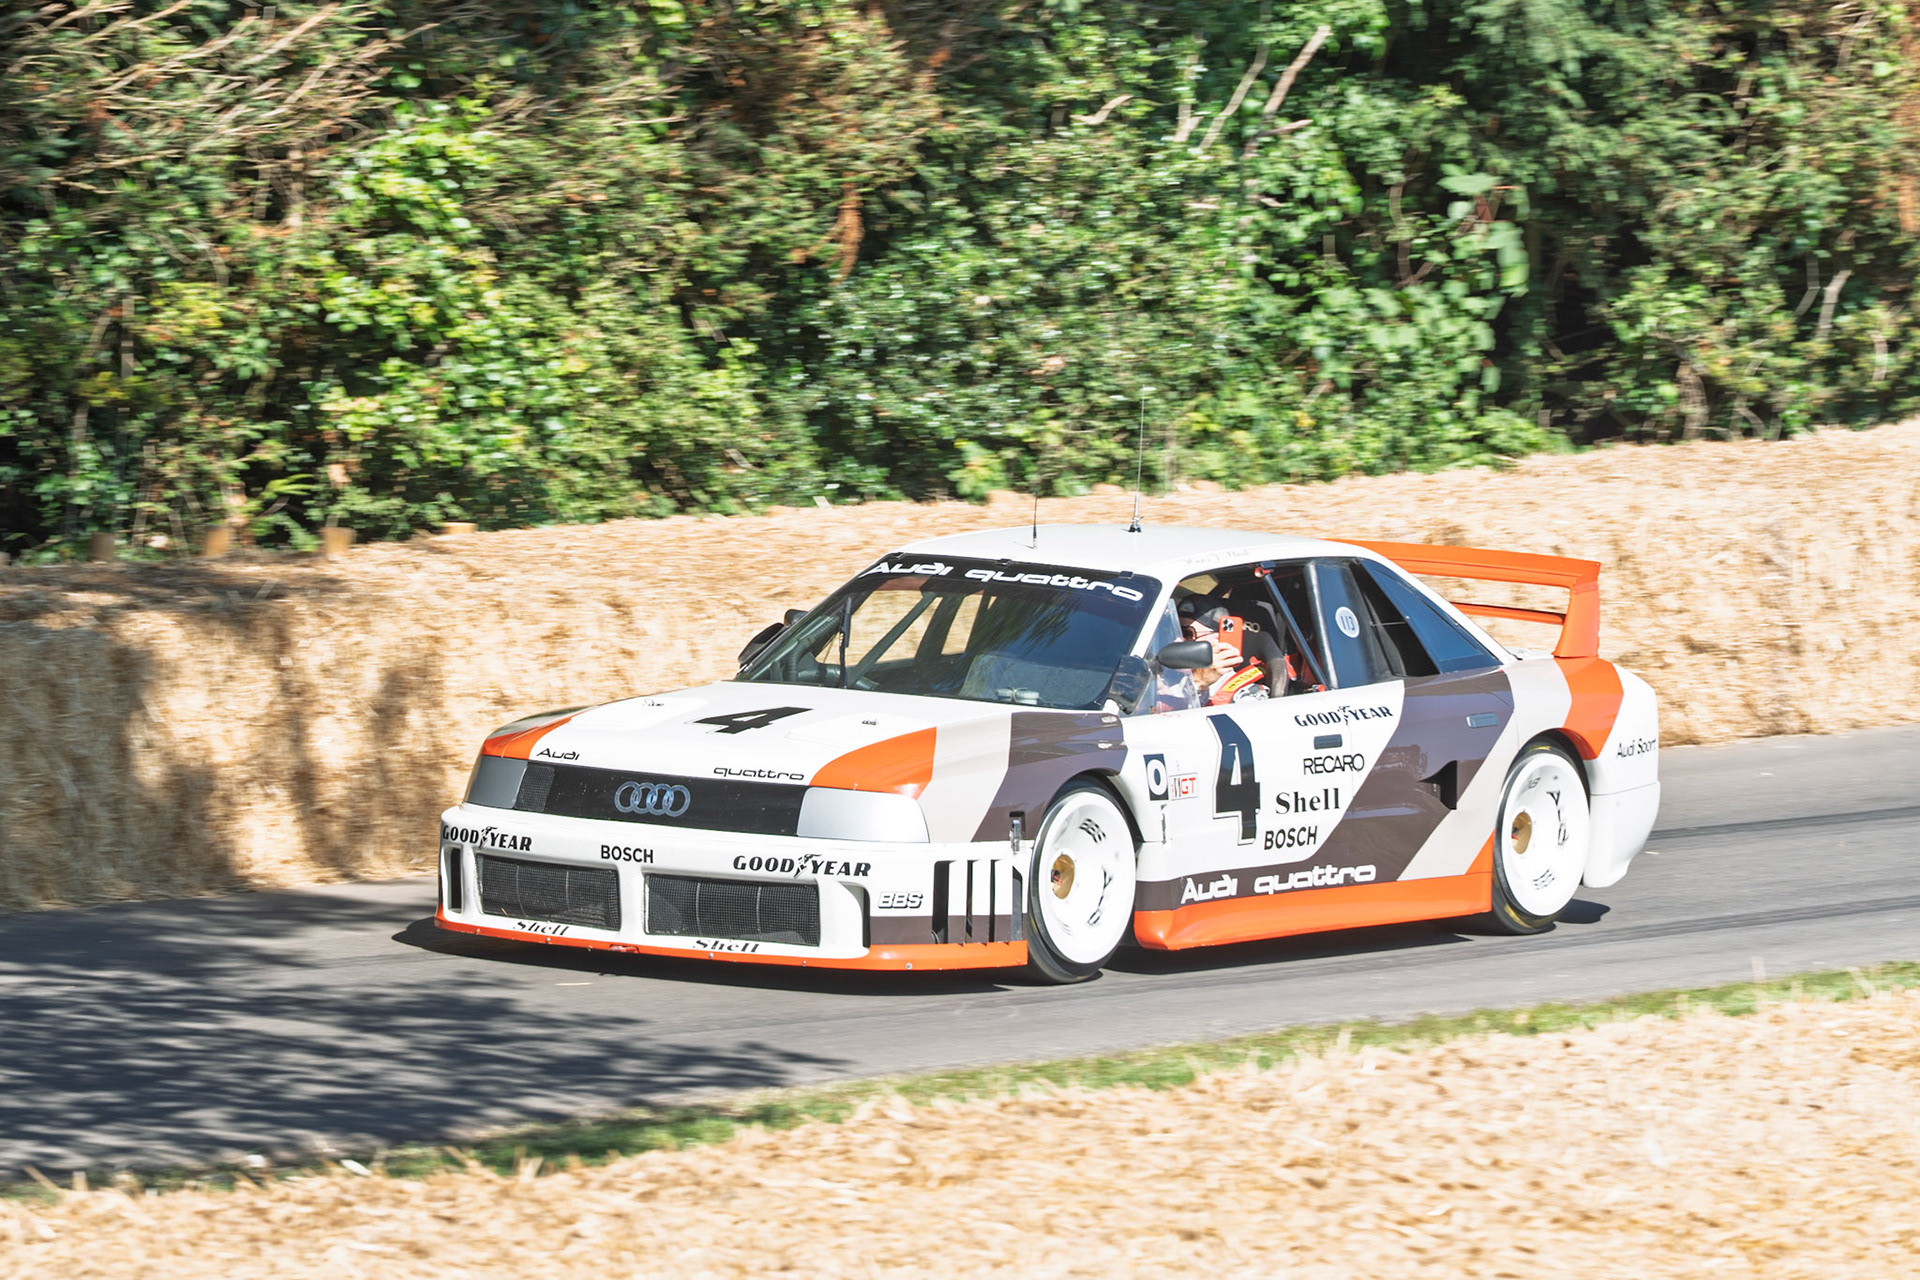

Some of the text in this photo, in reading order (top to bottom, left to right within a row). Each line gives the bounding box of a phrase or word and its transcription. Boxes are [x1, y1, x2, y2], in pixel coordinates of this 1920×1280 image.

[858, 562, 1144, 601] Audi quattro
[686, 706, 814, 735] 4
[1616, 740, 1636, 760] Audi
[536, 748, 805, 782] Audi quattro
[1303, 753, 1365, 775] RECARO
[1206, 713, 1261, 847] 4
[1276, 788, 1340, 815] Shell
[1264, 826, 1318, 850] BOSCH
[601, 845, 654, 864] BOSCH
[1181, 864, 1376, 904] Audi quattro
[878, 891, 923, 909] BBS
[513, 920, 570, 936] Shell
[693, 939, 760, 953] Shell
